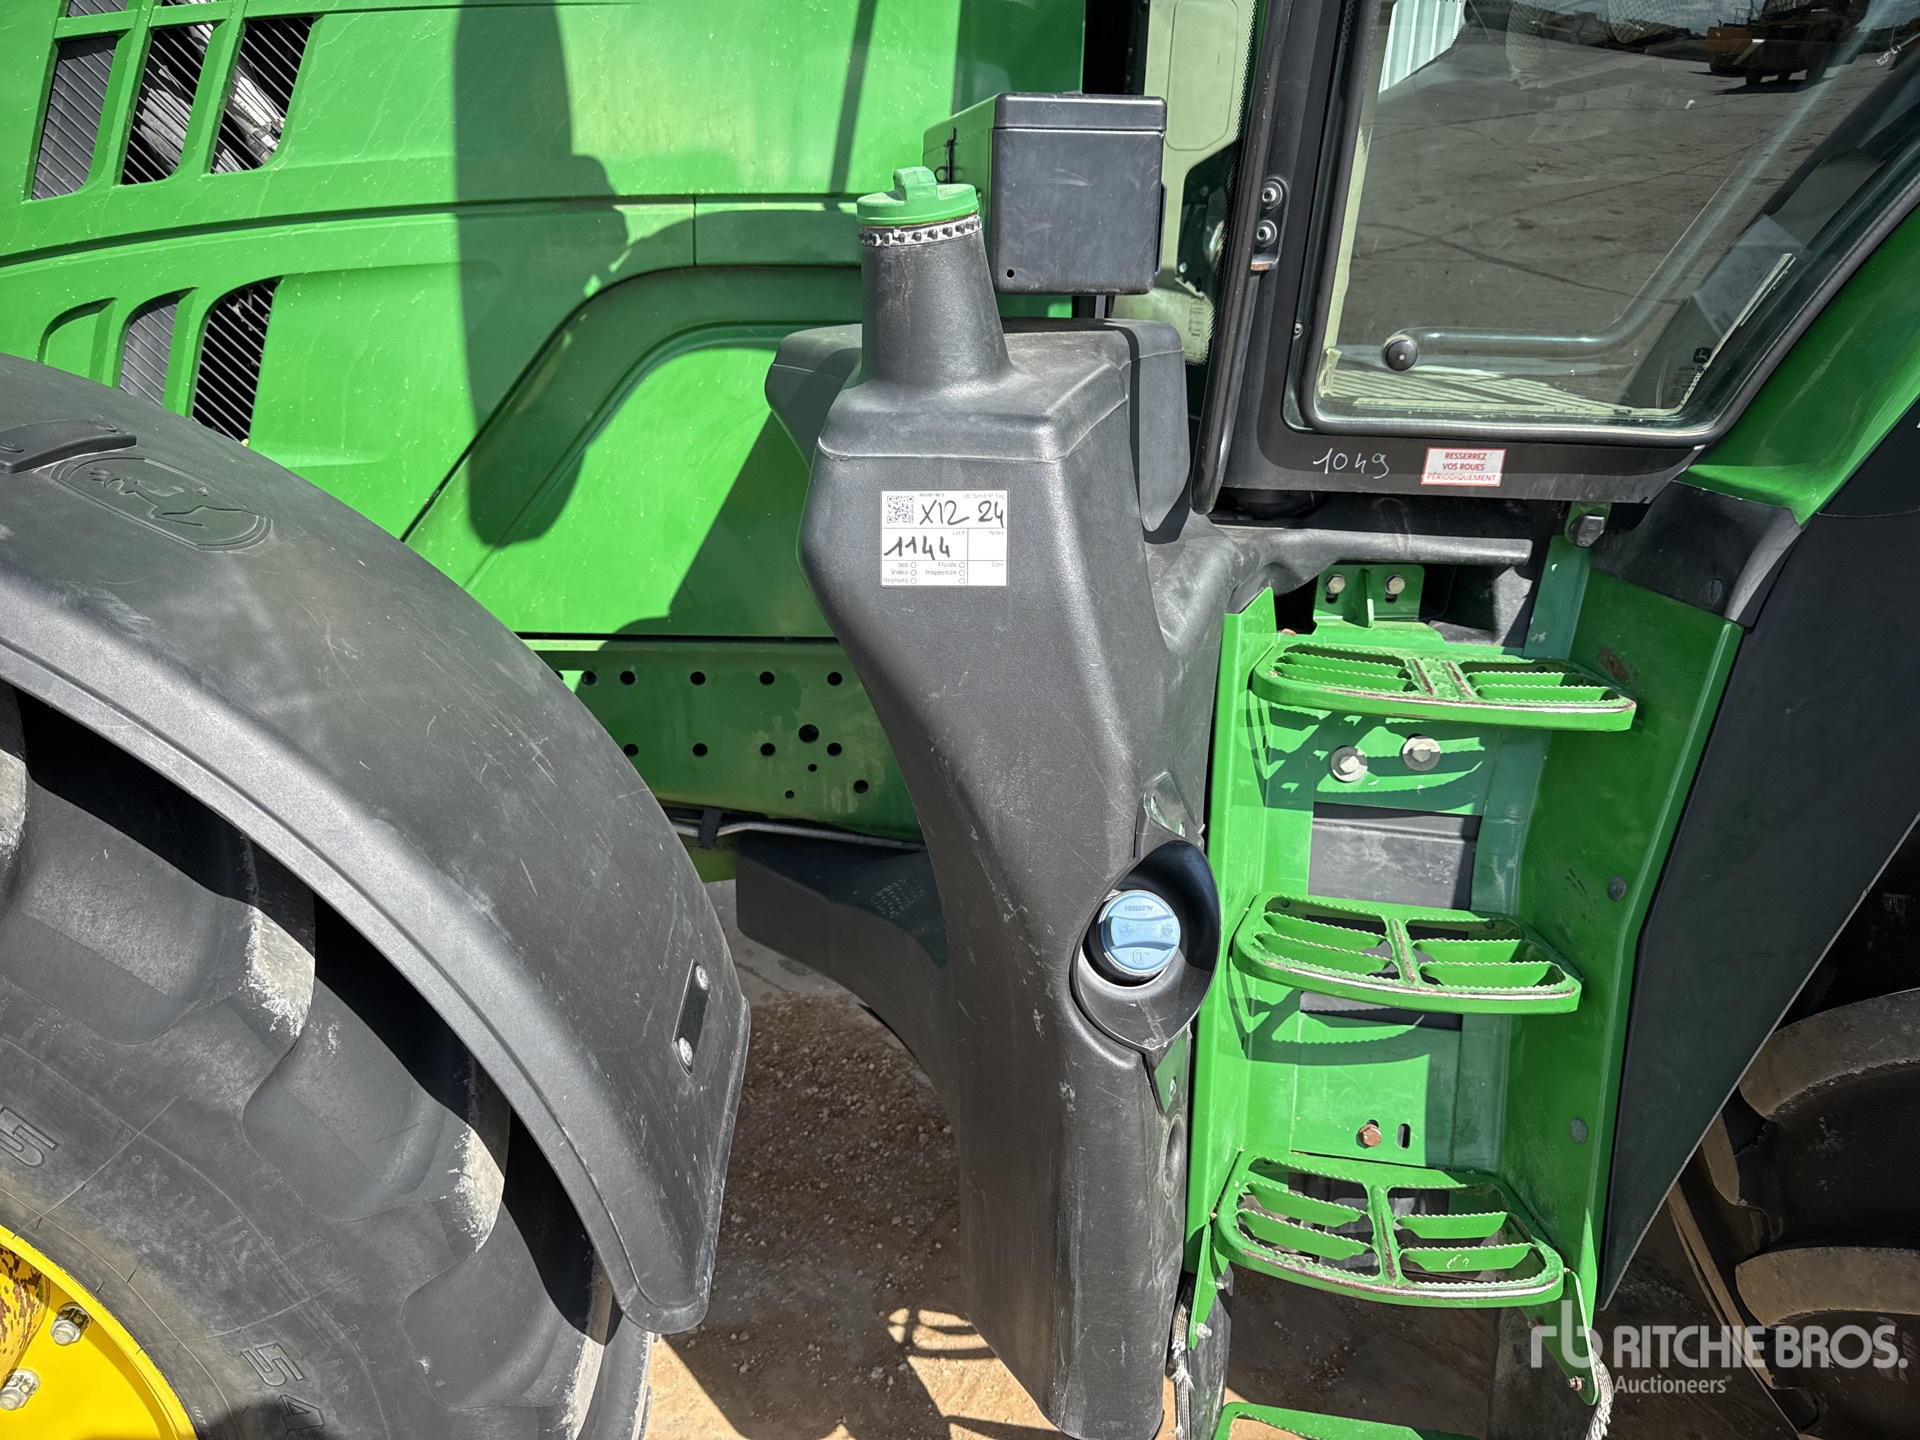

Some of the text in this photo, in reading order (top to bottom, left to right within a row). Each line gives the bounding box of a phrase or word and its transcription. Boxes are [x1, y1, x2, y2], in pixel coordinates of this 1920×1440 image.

[1444, 452, 1487, 460] RESSERREZ
[1442, 463, 1485, 471] VOS ROUES
[1426, 472, 1497, 482] PÉRIODIQUEMENT
[919, 499, 1005, 529] X12 24
[883, 535, 951, 561] 1144
[925, 569, 957, 577] Inspection
